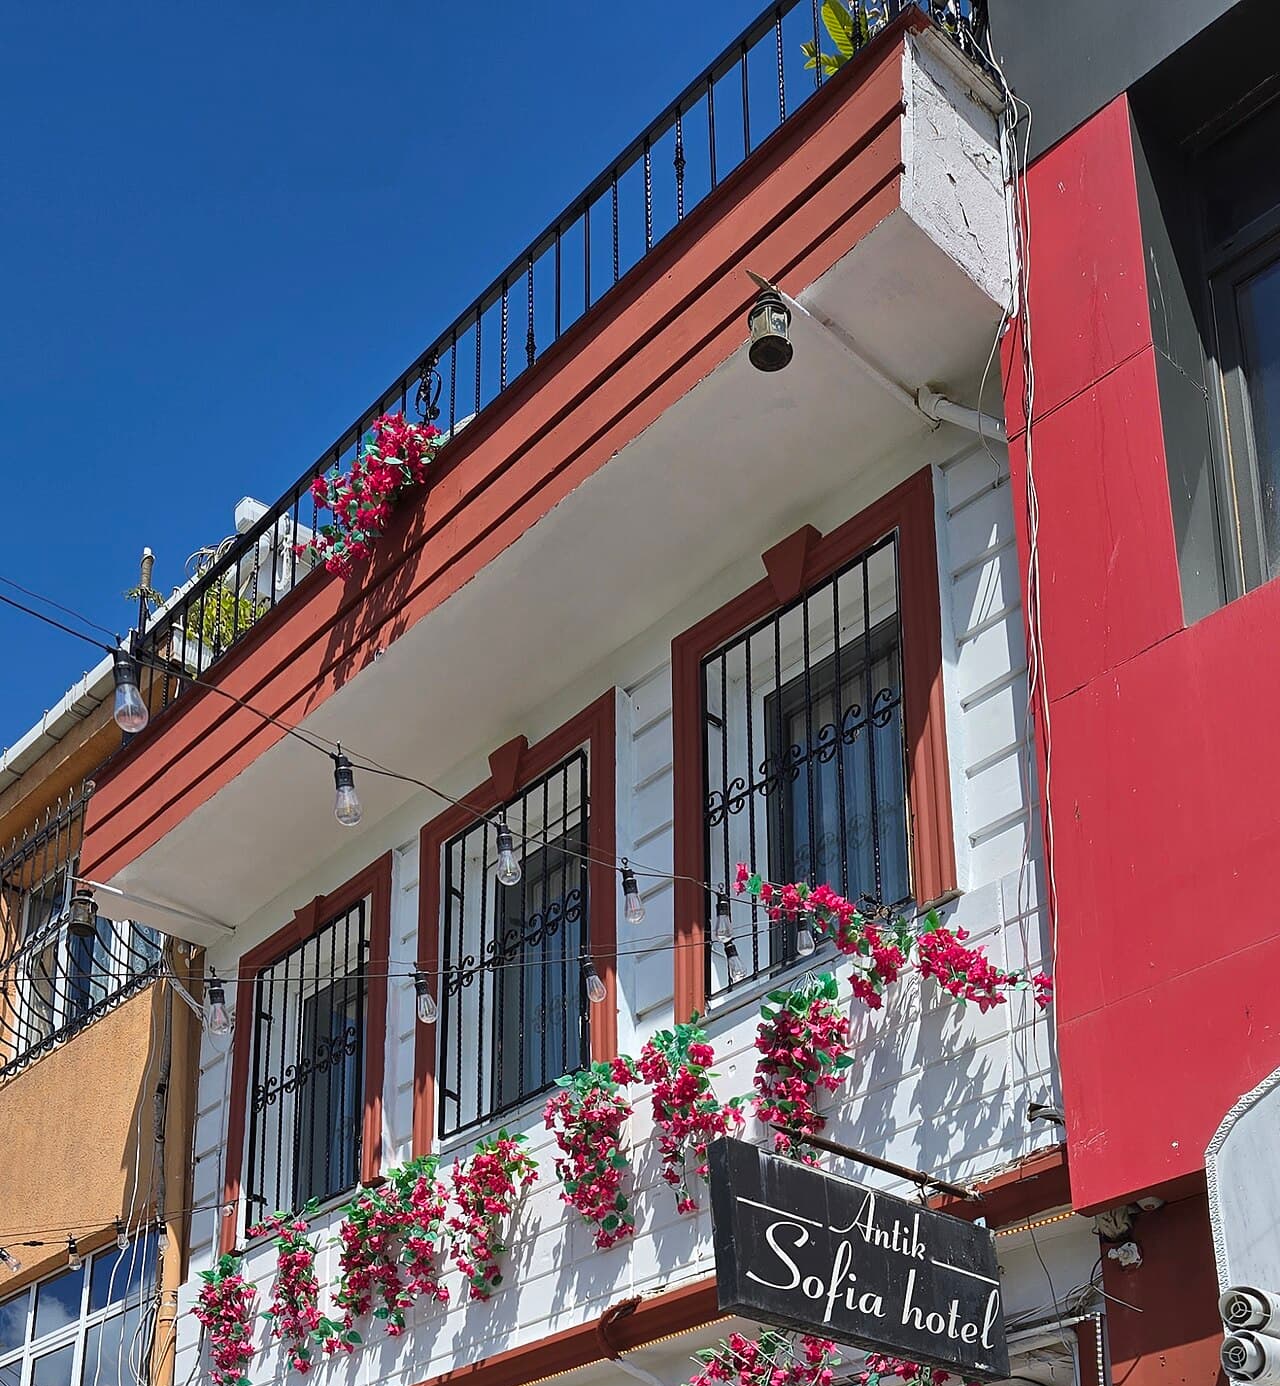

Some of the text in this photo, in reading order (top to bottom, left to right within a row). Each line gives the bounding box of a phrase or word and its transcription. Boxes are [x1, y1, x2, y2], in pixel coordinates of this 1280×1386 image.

[828, 1191, 926, 1261] Antik
[745, 1221, 1000, 1350] Sofia hotel
